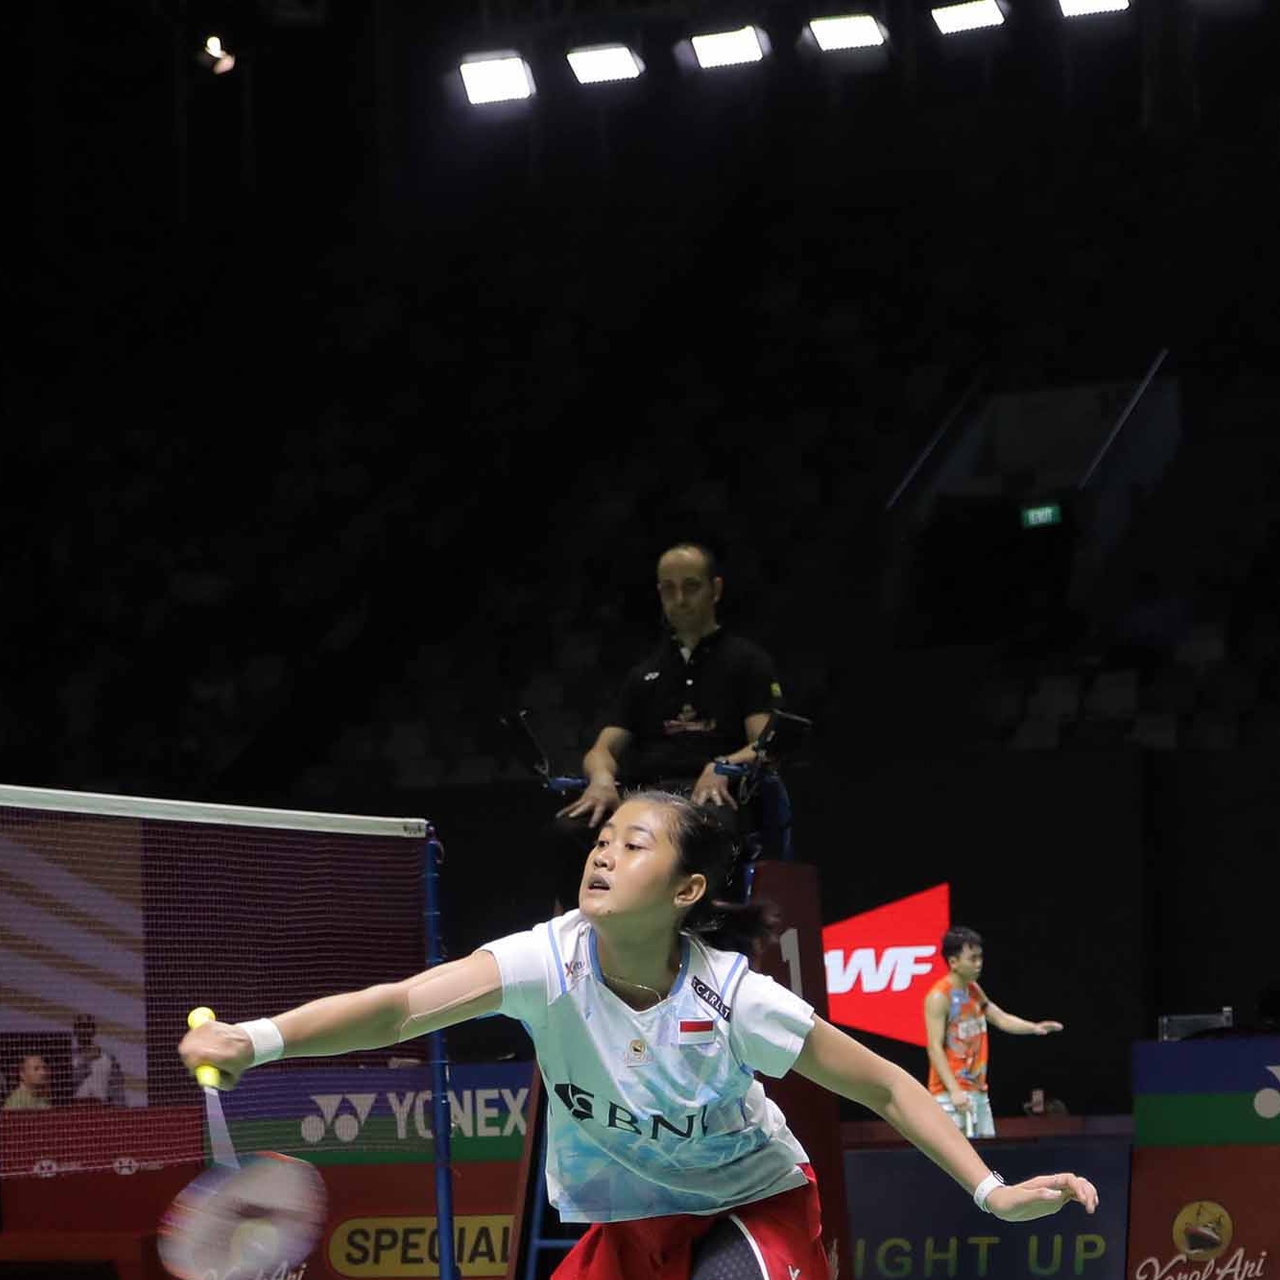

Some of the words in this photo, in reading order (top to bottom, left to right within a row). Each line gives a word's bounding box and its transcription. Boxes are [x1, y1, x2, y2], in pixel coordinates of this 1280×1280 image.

[823, 945, 937, 994] WF
[606, 1101, 709, 1139] BNI
[854, 1236, 1001, 1279] IGHT
[1027, 1233, 1107, 1276] UP
